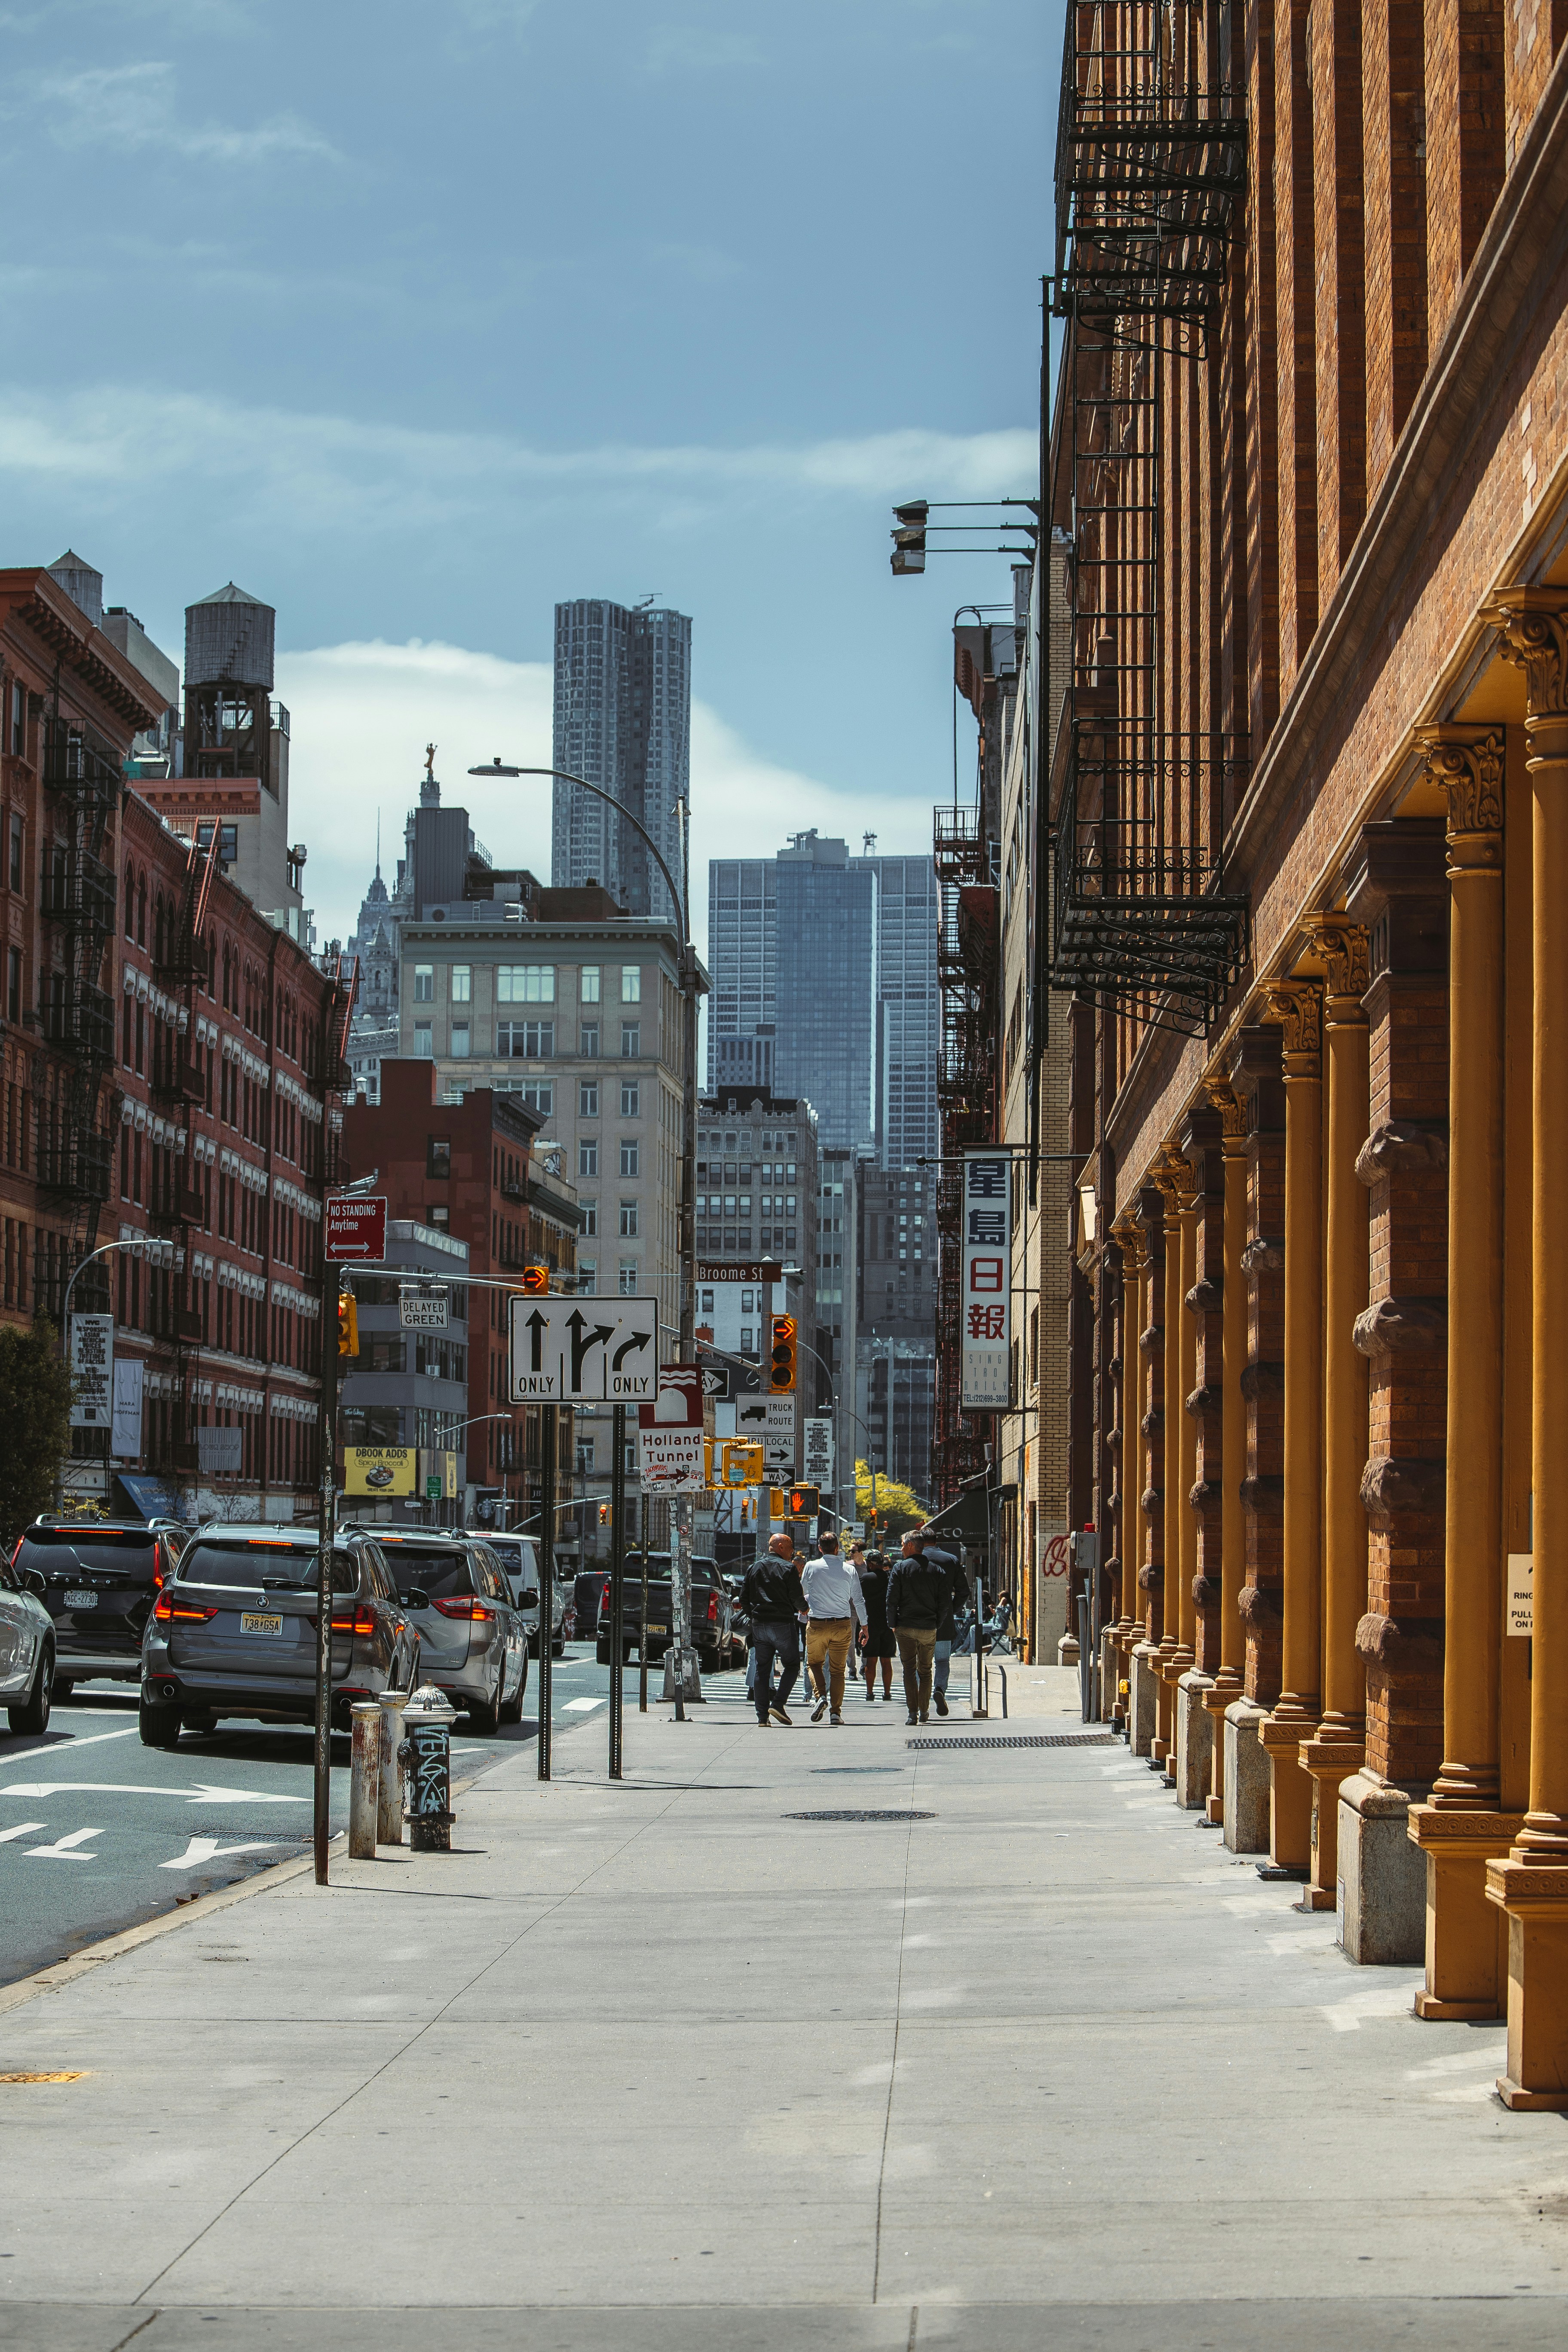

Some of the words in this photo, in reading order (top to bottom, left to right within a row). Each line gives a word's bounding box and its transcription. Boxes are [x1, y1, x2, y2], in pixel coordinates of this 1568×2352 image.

[331, 1205, 340, 1216] NO
[342, 1204, 376, 1216] STANDING
[330, 1219, 358, 1233] Anytime
[968, 1161, 1006, 1340] 星島日報
[700, 1267, 746, 1280] Broome
[752, 1267, 763, 1280] St
[403, 1302, 444, 1312] DELAYED
[405, 1314, 444, 1325] GREEN
[970, 1354, 1001, 1364] SING
[974, 1367, 997, 1377] TAO
[519, 1377, 554, 1393] ONLY
[613, 1377, 649, 1393] ONLY
[702, 1377, 716, 1388] AY
[965, 1381, 1006, 1390] DAILY
[768, 1417, 793, 1425] ROUTE
[643, 1433, 701, 1446] Holland
[766, 1438, 793, 1446] LOCAL
[356, 1448, 383, 1458] DBOOK
[386, 1449, 407, 1458] ADDS
[646, 1450, 698, 1463] Tunnel
[645, 1464, 668, 1477] ZACKWOODS
[769, 1473, 786, 1481] WAY
[67, 1594, 77, 1603] KGC
[81, 1595, 95, 1604] 2730
[245, 1618, 259, 1629] T38
[264, 1620, 279, 1631] GSA
